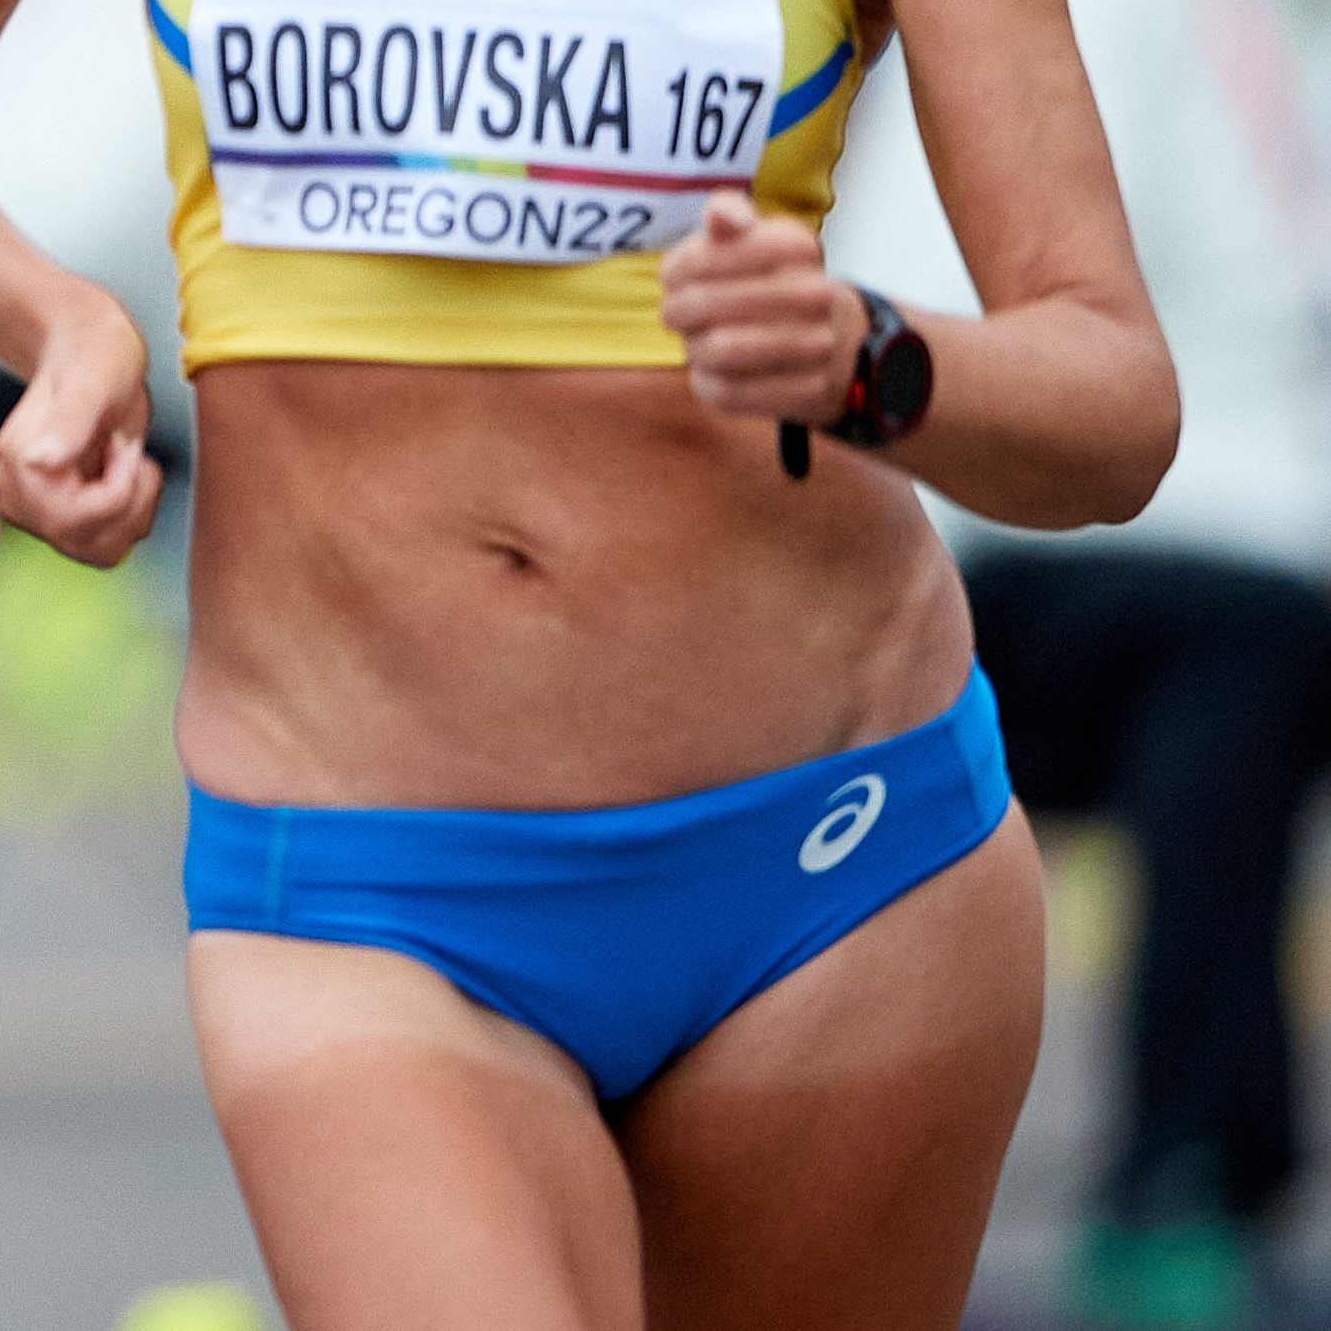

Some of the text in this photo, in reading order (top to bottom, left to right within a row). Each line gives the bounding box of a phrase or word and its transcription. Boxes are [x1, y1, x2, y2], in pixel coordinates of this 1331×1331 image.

[217, 21, 764, 163] BOROVSKA 167
[298, 180, 652, 253] OREGON22
